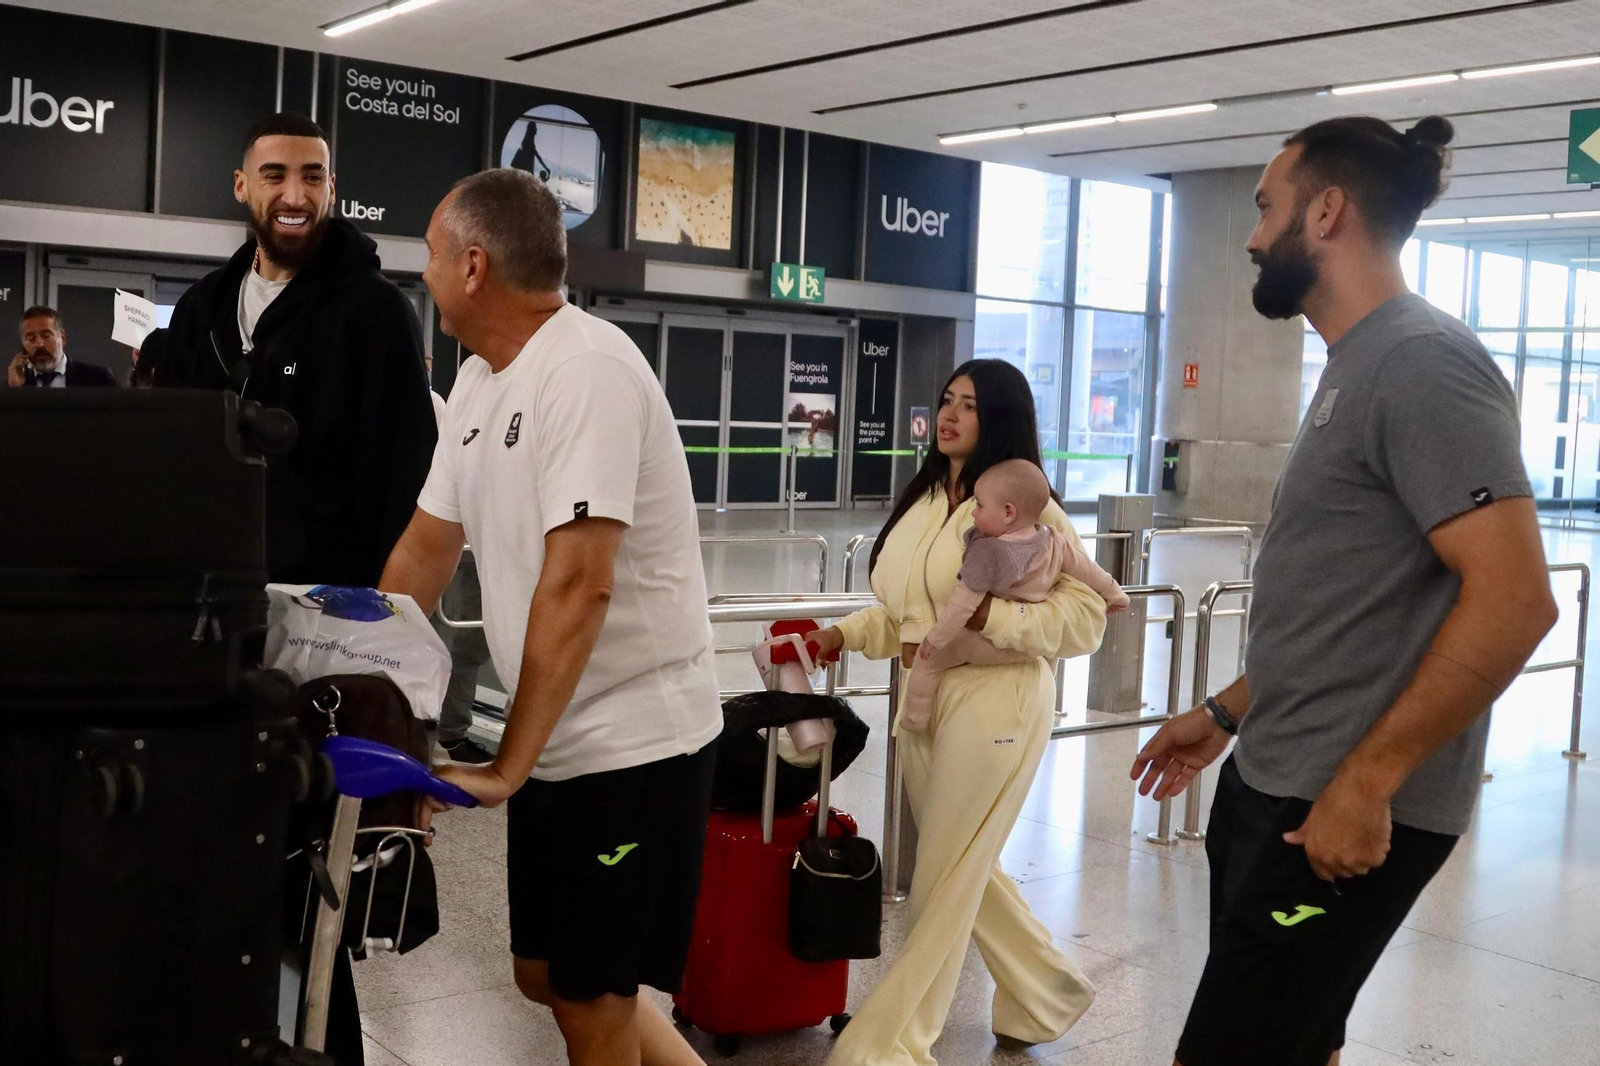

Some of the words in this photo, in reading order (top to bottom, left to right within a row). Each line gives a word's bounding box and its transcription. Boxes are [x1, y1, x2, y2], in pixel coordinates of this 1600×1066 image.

[346, 68, 382, 90] See
[385, 78, 418, 96] you
[421, 79, 436, 98] in
[345, 92, 399, 116] Costa
[402, 100, 430, 120] del
[433, 104, 460, 124] Sol
[341, 199, 386, 221] Uber
[881, 194, 950, 237] Uber
[863, 341, 889, 357] Uber
[790, 361, 805, 371] See
[806, 363, 820, 374] you
[821, 362, 828, 372] in
[790, 372, 829, 385] Fuengirola
[859, 420, 870, 428] See
[868, 429, 886, 437] pickup
